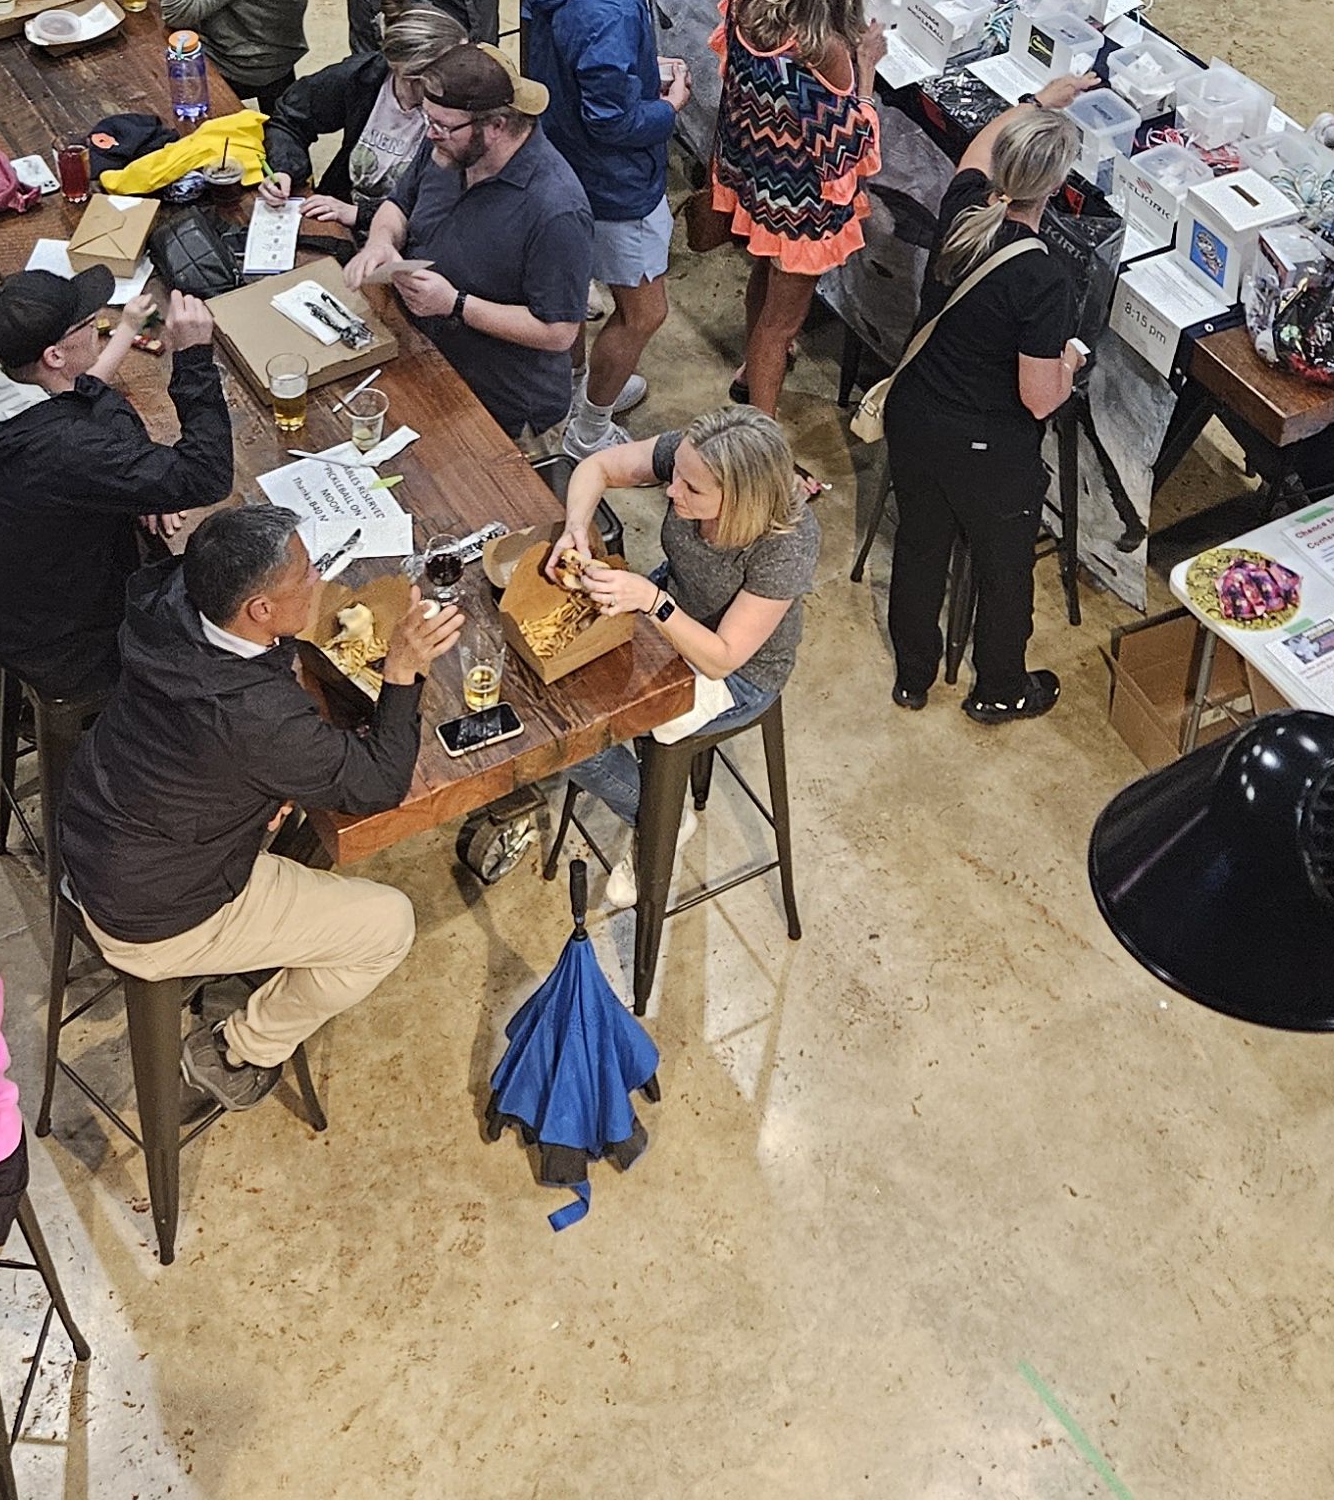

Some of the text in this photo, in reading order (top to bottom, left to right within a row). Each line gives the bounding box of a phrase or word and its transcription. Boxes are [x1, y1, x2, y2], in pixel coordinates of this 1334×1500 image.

[1118, 174, 1171, 220] SELKIRK
[1041, 225, 1089, 264] KIRK
[1124, 301, 1148, 328] 8:15
[1148, 325, 1167, 345] pm
[323, 463, 363, 517] "PICKLEBALL ON
[341, 464, 361, 487] ABLES
[321, 488, 346, 515] MOON"
[1295, 520, 1328, 540] Chance
